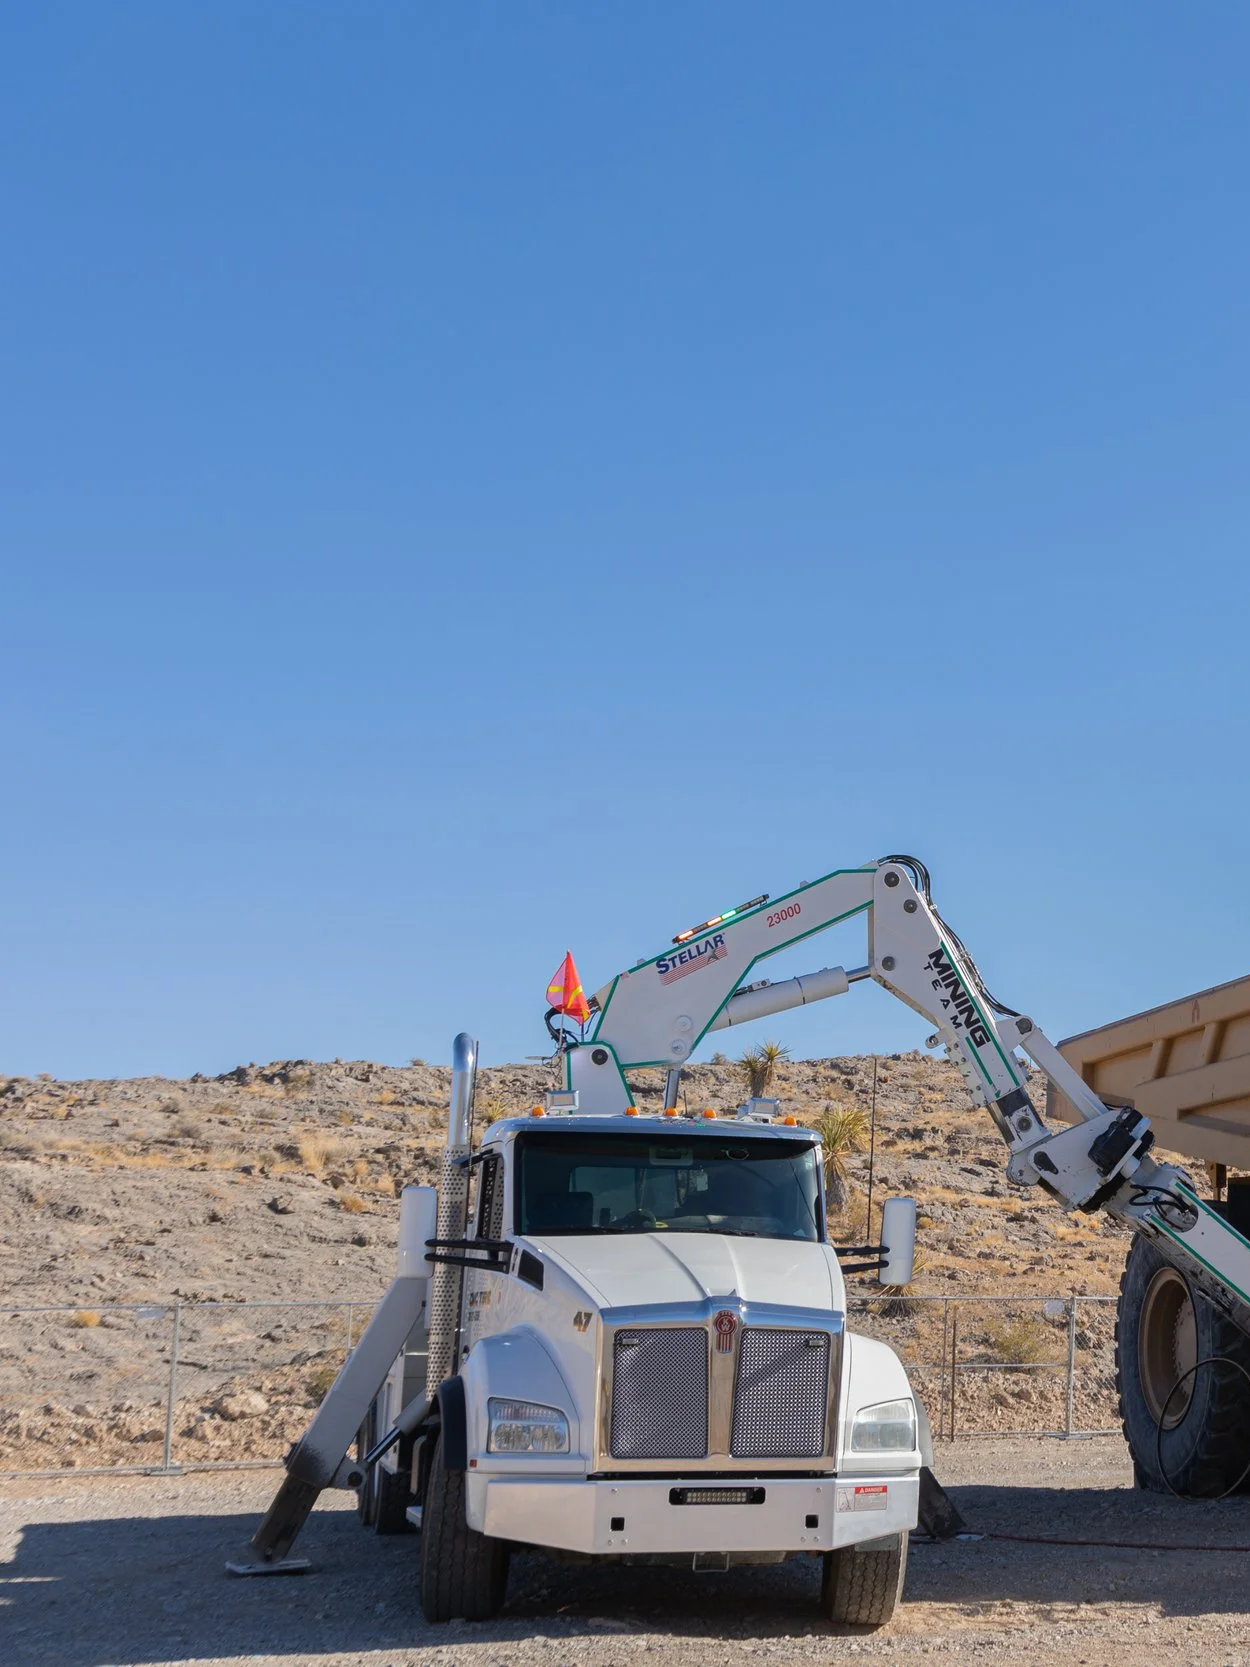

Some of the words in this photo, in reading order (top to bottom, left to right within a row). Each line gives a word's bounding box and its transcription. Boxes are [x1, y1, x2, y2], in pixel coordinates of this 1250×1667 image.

[766, 903, 801, 928] 23000
[655, 933, 725, 975] STELLAR
[923, 962, 963, 1030] TEAM
[928, 948, 991, 1048] MINING
[573, 1311, 593, 1333] 47
